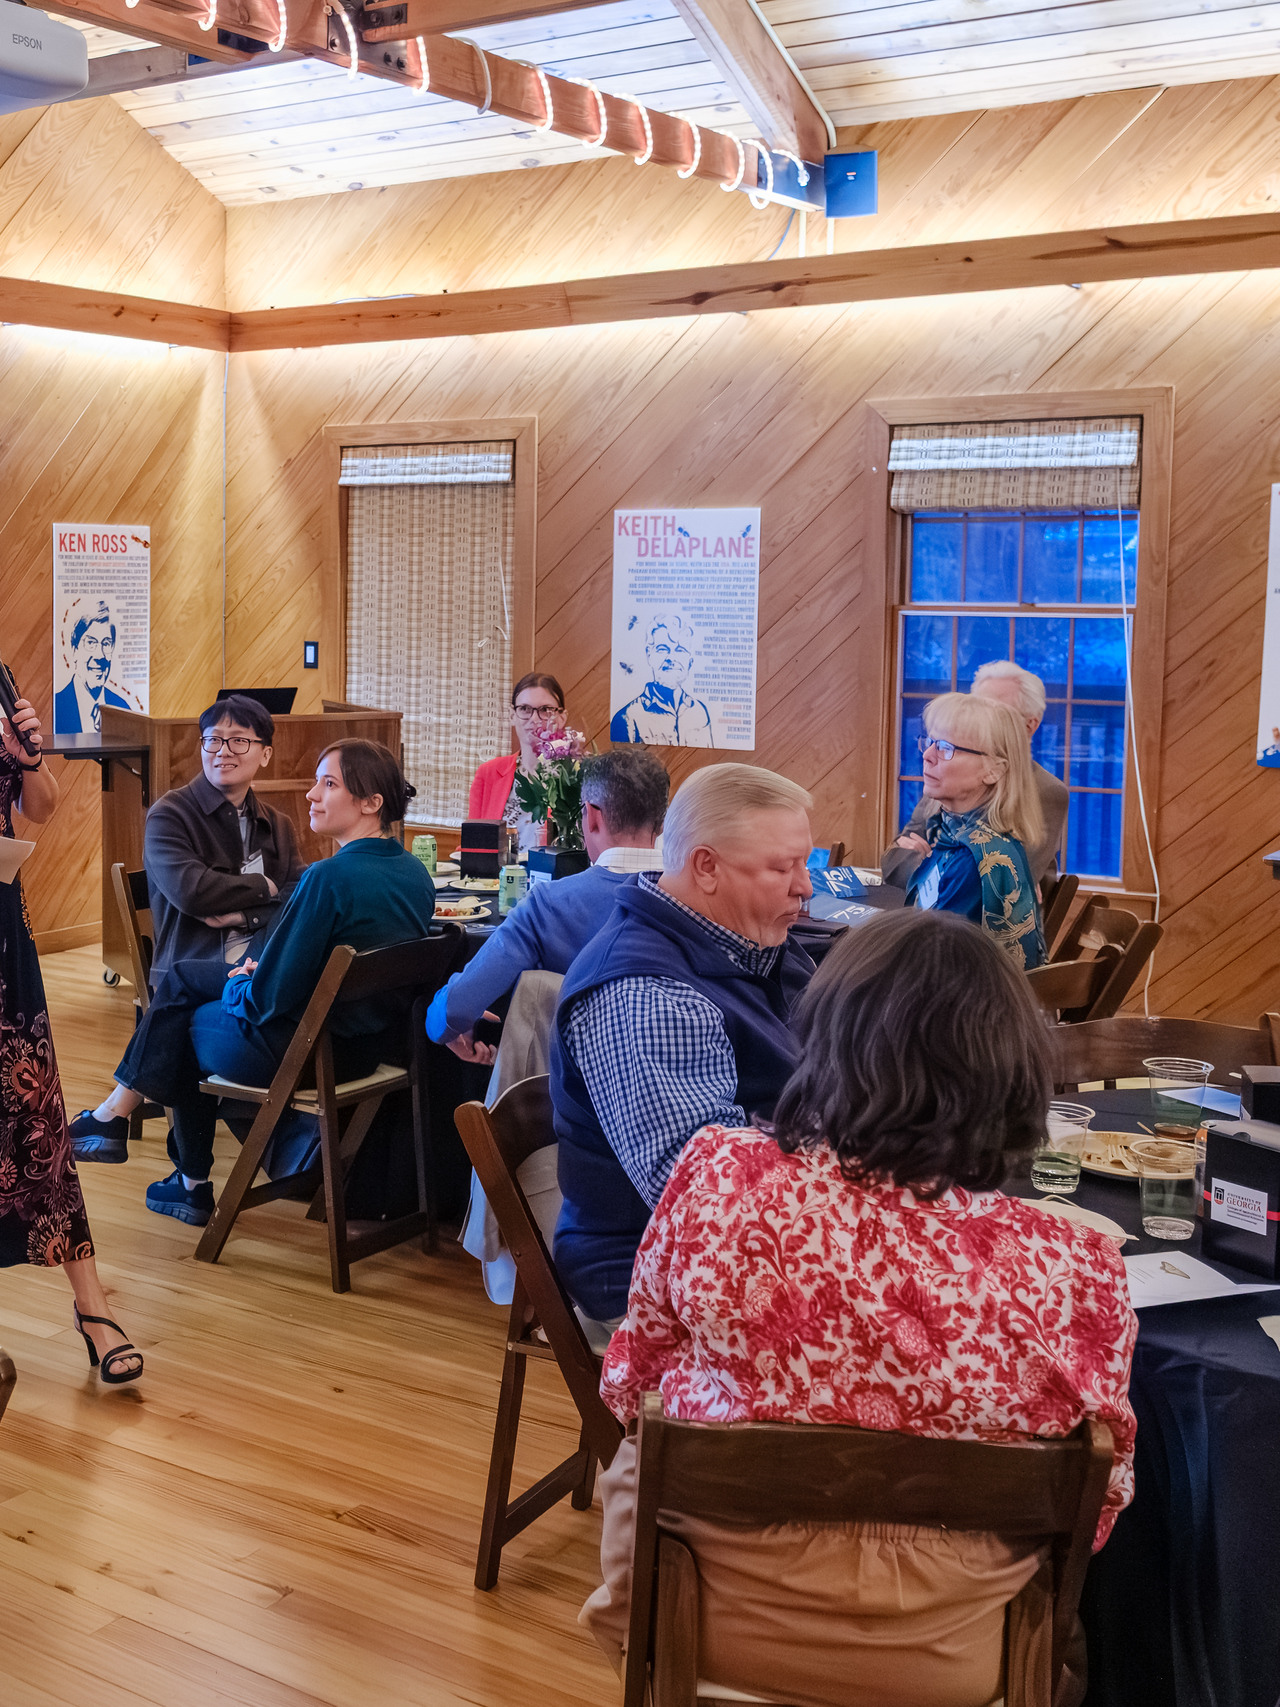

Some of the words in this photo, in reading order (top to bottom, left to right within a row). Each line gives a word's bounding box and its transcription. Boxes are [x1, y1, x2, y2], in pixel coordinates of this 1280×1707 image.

[12, 33, 42, 50] EPSON
[618, 516, 676, 536] KEITH
[59, 533, 86, 552] KEN
[92, 533, 127, 553] ROSS
[637, 536, 756, 559] DELAPLANE
[823, 870, 851, 892] 75
[833, 905, 865, 920] 75
[1226, 1197, 1262, 1213] GEORGIA
